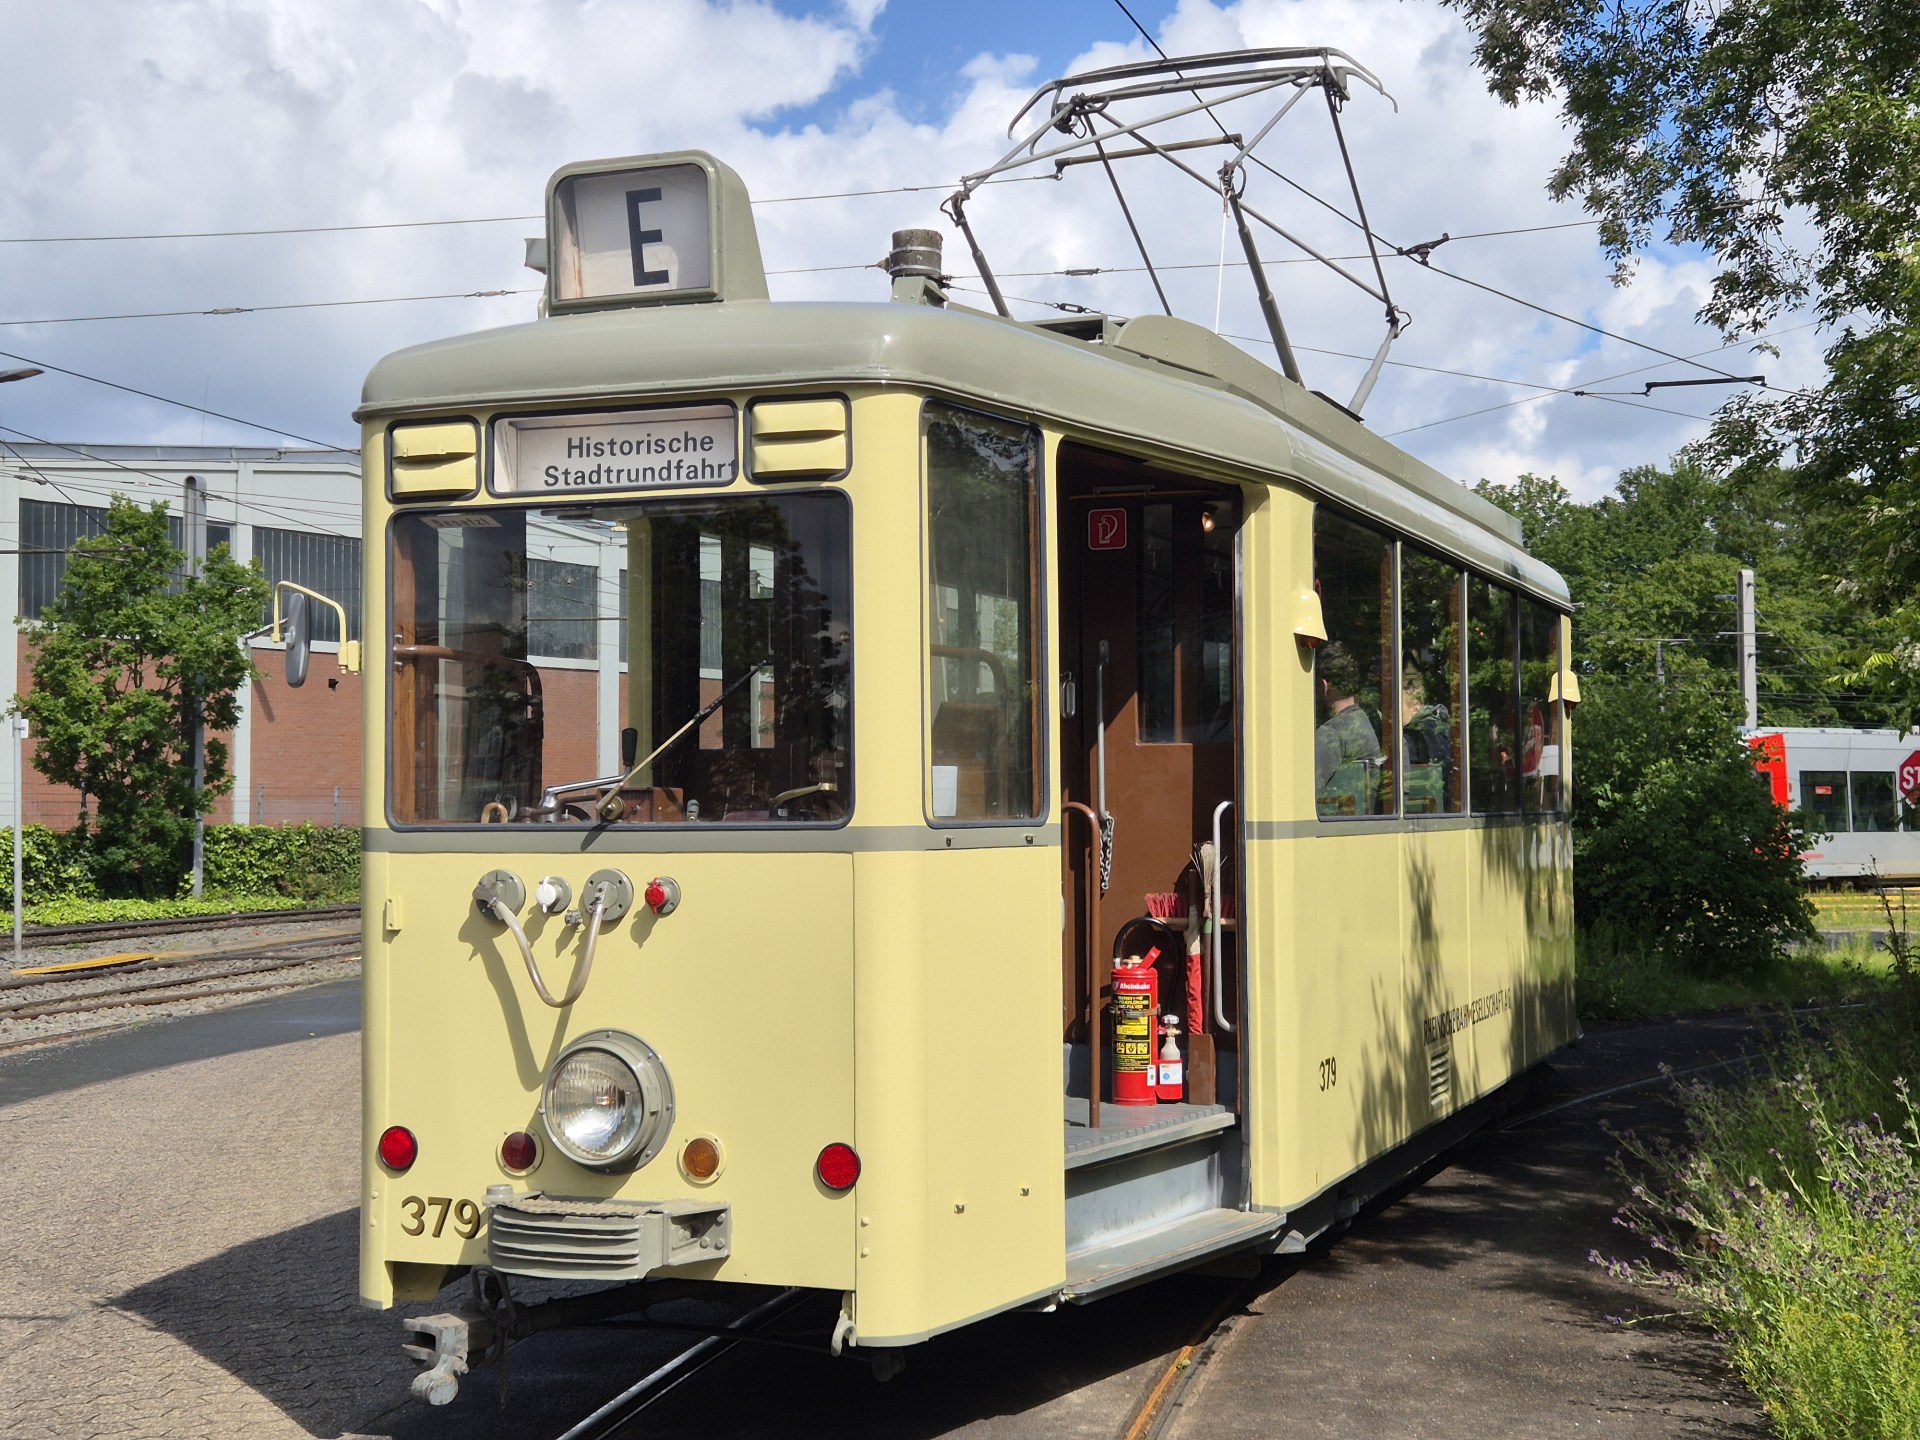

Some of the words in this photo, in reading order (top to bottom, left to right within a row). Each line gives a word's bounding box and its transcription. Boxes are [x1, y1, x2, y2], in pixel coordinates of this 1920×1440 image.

[626, 187, 670, 286] E
[567, 431, 715, 459] Historische
[1456, 990, 1503, 1033] BAHNESELLSCHAFT
[1319, 1056, 1337, 1092] 379
[401, 1195, 481, 1240] 379
